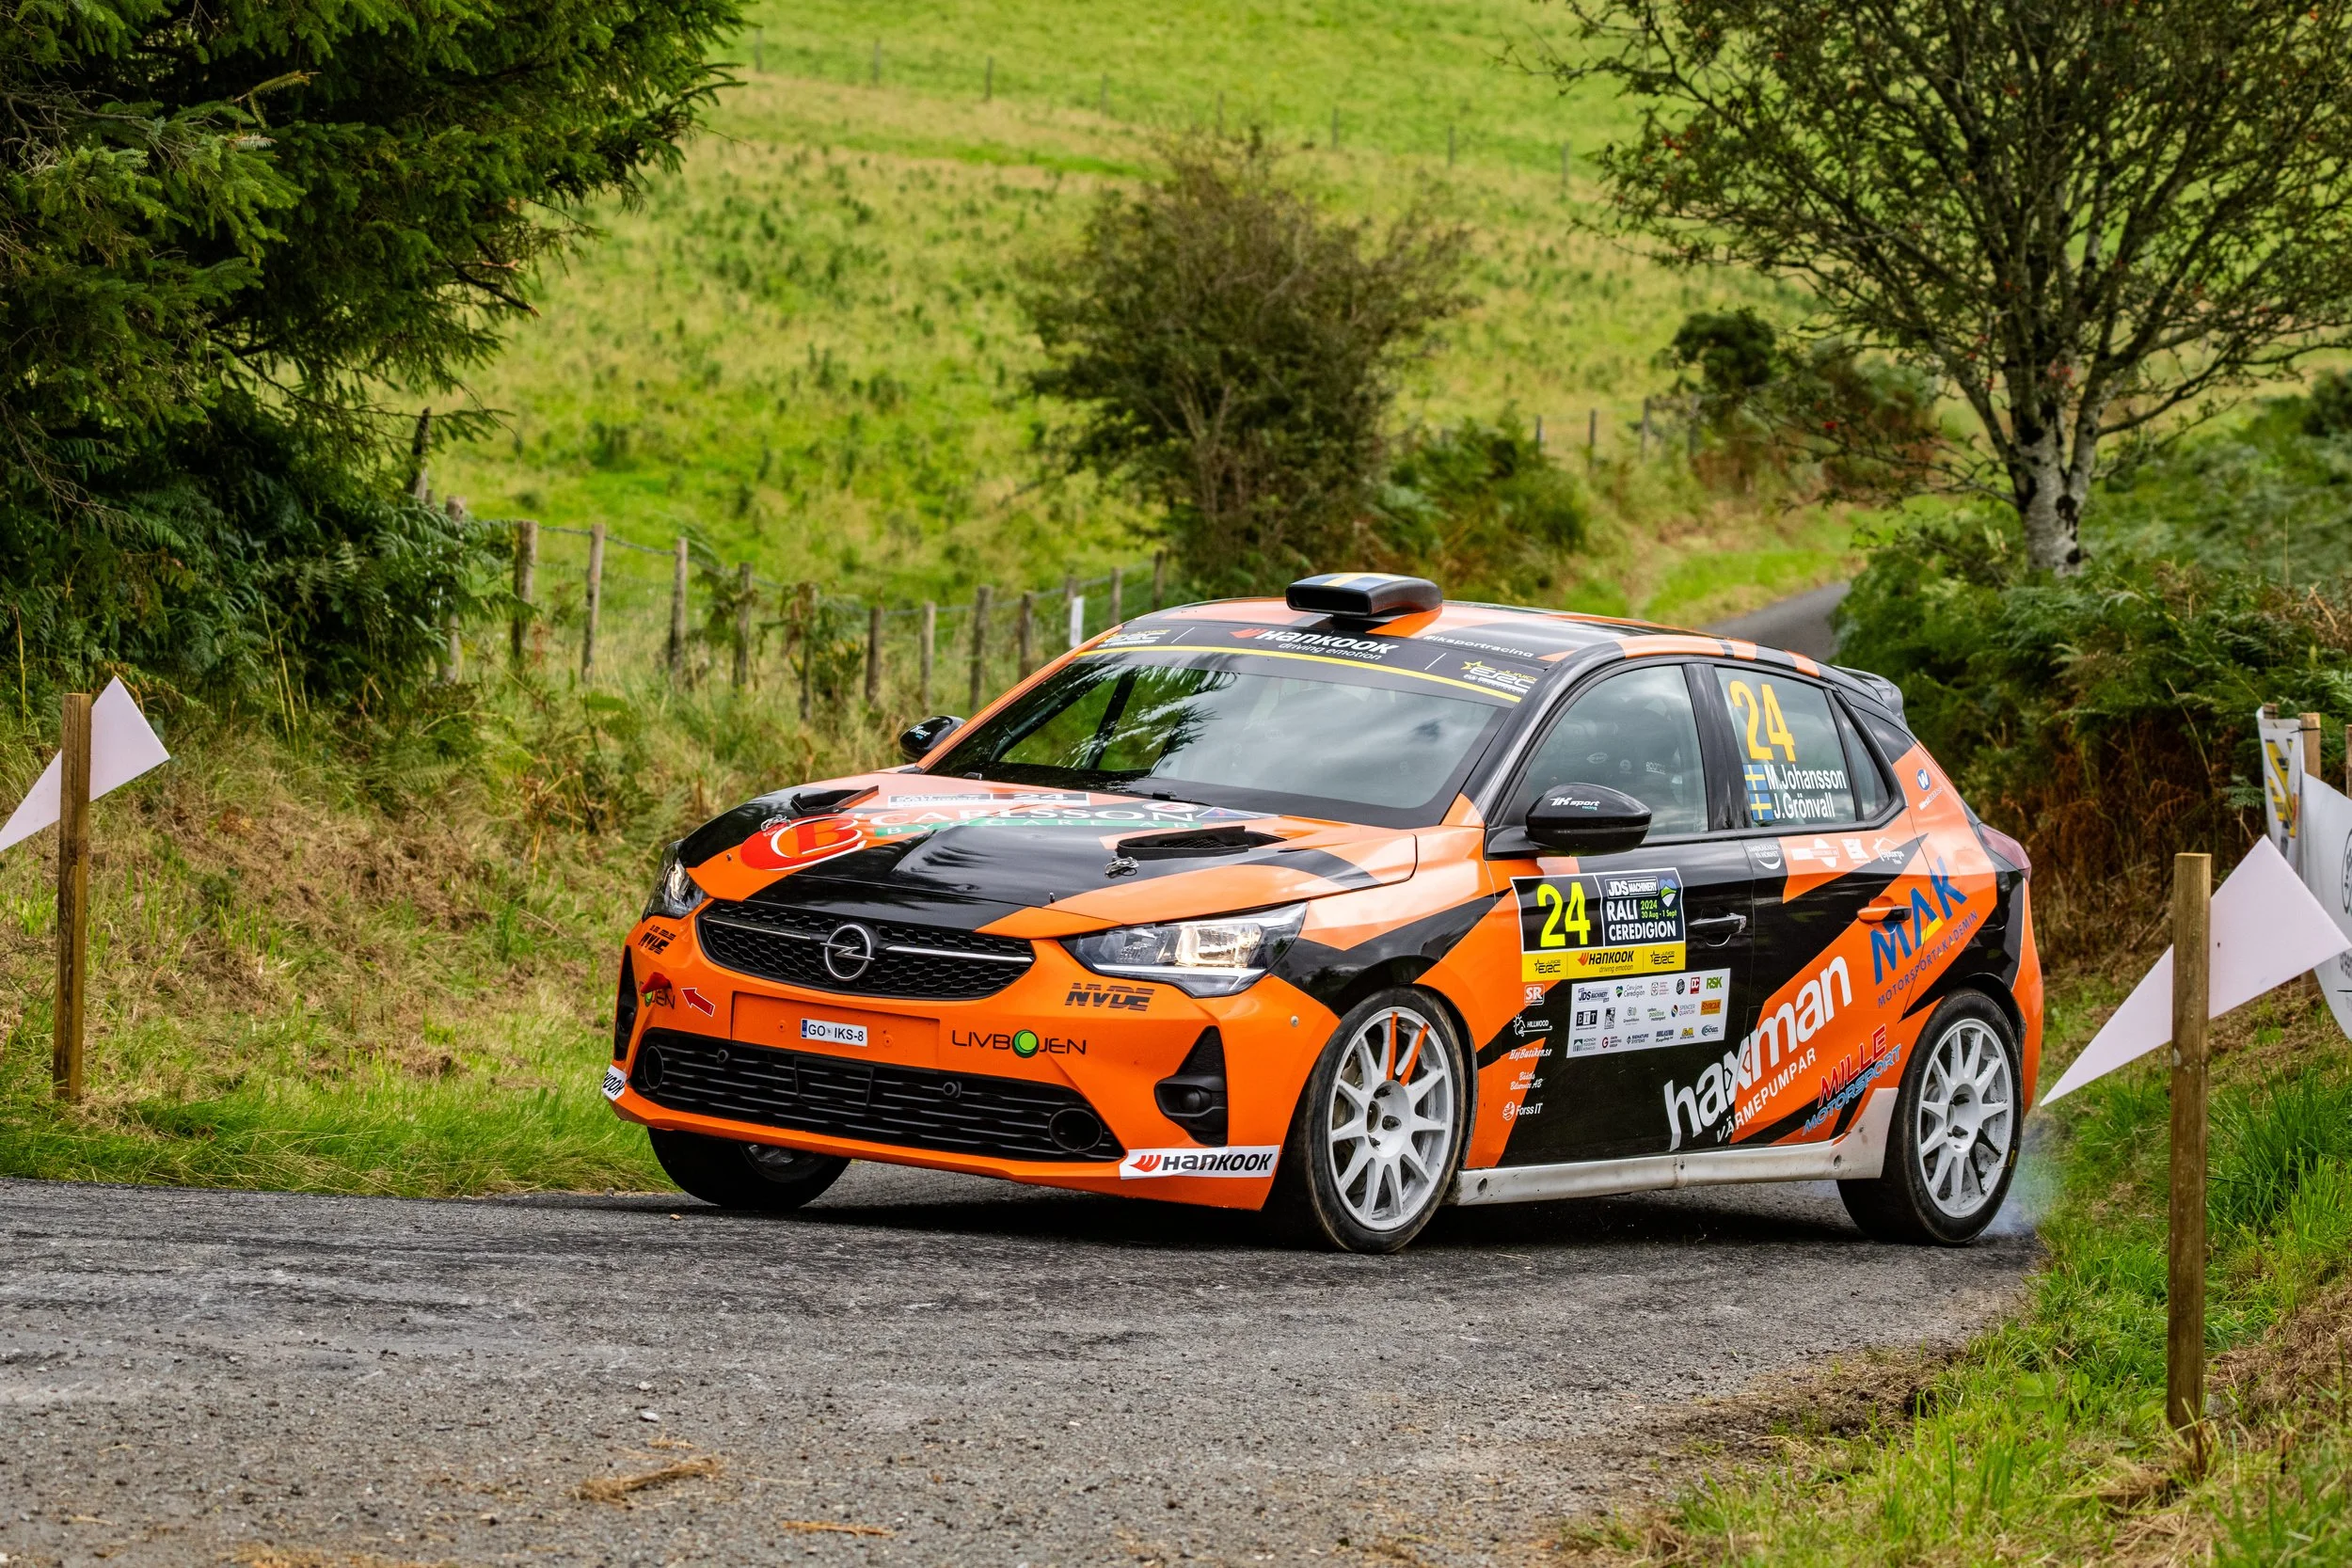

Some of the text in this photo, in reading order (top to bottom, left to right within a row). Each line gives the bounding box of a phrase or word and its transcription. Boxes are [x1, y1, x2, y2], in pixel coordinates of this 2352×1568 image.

[1278, 641, 1383, 660] driving emotion
[1729, 680, 1797, 762] 24
[1764, 764, 1848, 790] M.Johansson
[1773, 792, 1836, 819] J.Grönvall
[1608, 879, 1657, 896] JDS MACHINERY
[1536, 881, 1591, 948] 24
[1606, 899, 1639, 922] RALI
[1640, 899, 1658, 910] 2024
[1641, 911, 1648, 919] 30
[1648, 911, 1659, 920] Aug
[1666, 909, 1677, 918] Sept
[1608, 920, 1677, 942] CEREDIGION
[1869, 856, 1968, 986] MAK
[1599, 964, 1634, 974] driving emotion
[1878, 910, 1979, 1008] MOTORSPORTAKADEMIN
[1526, 986, 1543, 1000] SR
[1706, 976, 1723, 990] RSK
[808, 1024, 826, 1037] GO
[834, 1027, 864, 1041] IKS-8
[1663, 956, 1852, 1152] haxman
[1818, 1023, 1886, 1109] MILLE
[1716, 1047, 1817, 1143] VÄRMEPUMPAR
[1801, 1043, 1902, 1137] MOTORSPORT
[1516, 1102, 1543, 1117] Forss IT
